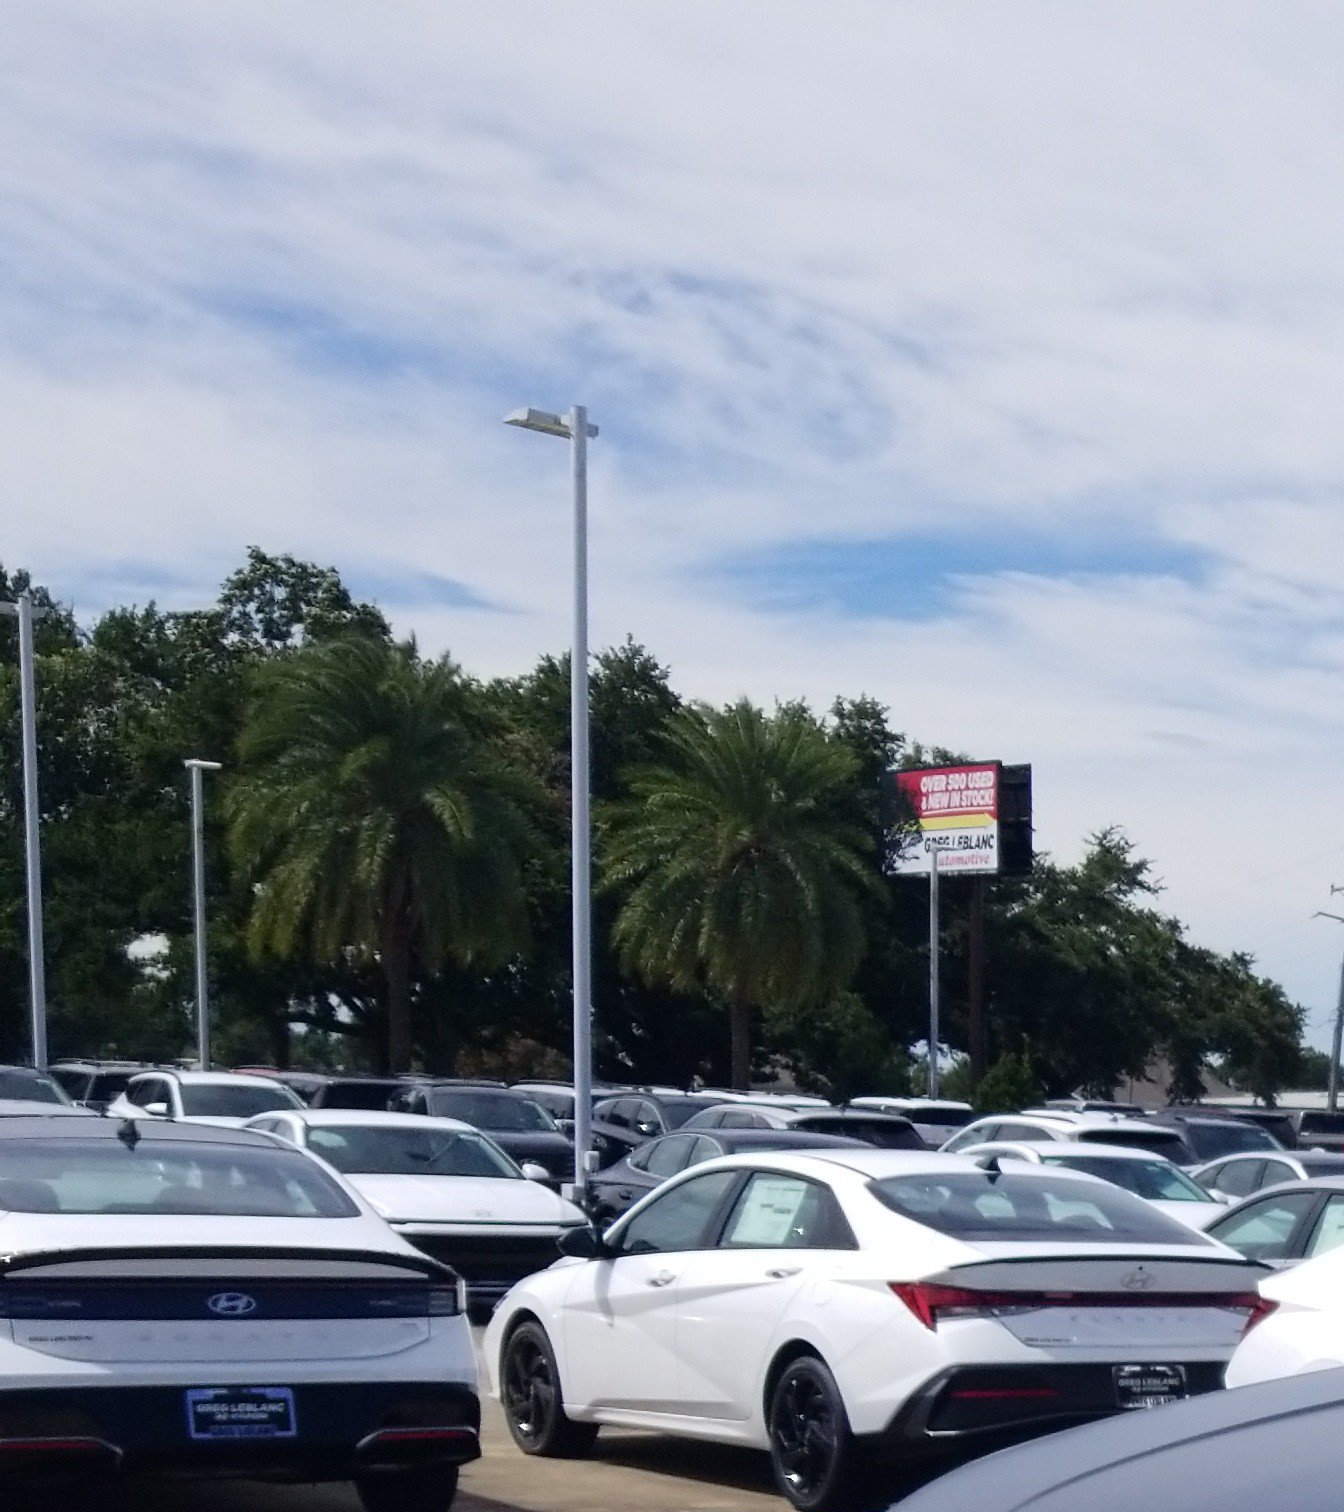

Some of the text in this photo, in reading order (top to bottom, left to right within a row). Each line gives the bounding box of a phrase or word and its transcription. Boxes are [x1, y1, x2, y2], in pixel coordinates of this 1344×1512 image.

[921, 774, 947, 793] OVER
[967, 770, 994, 790] USED
[927, 792, 950, 810] NEW
[950, 790, 961, 808] IN
[938, 854, 990, 866] utomotive
